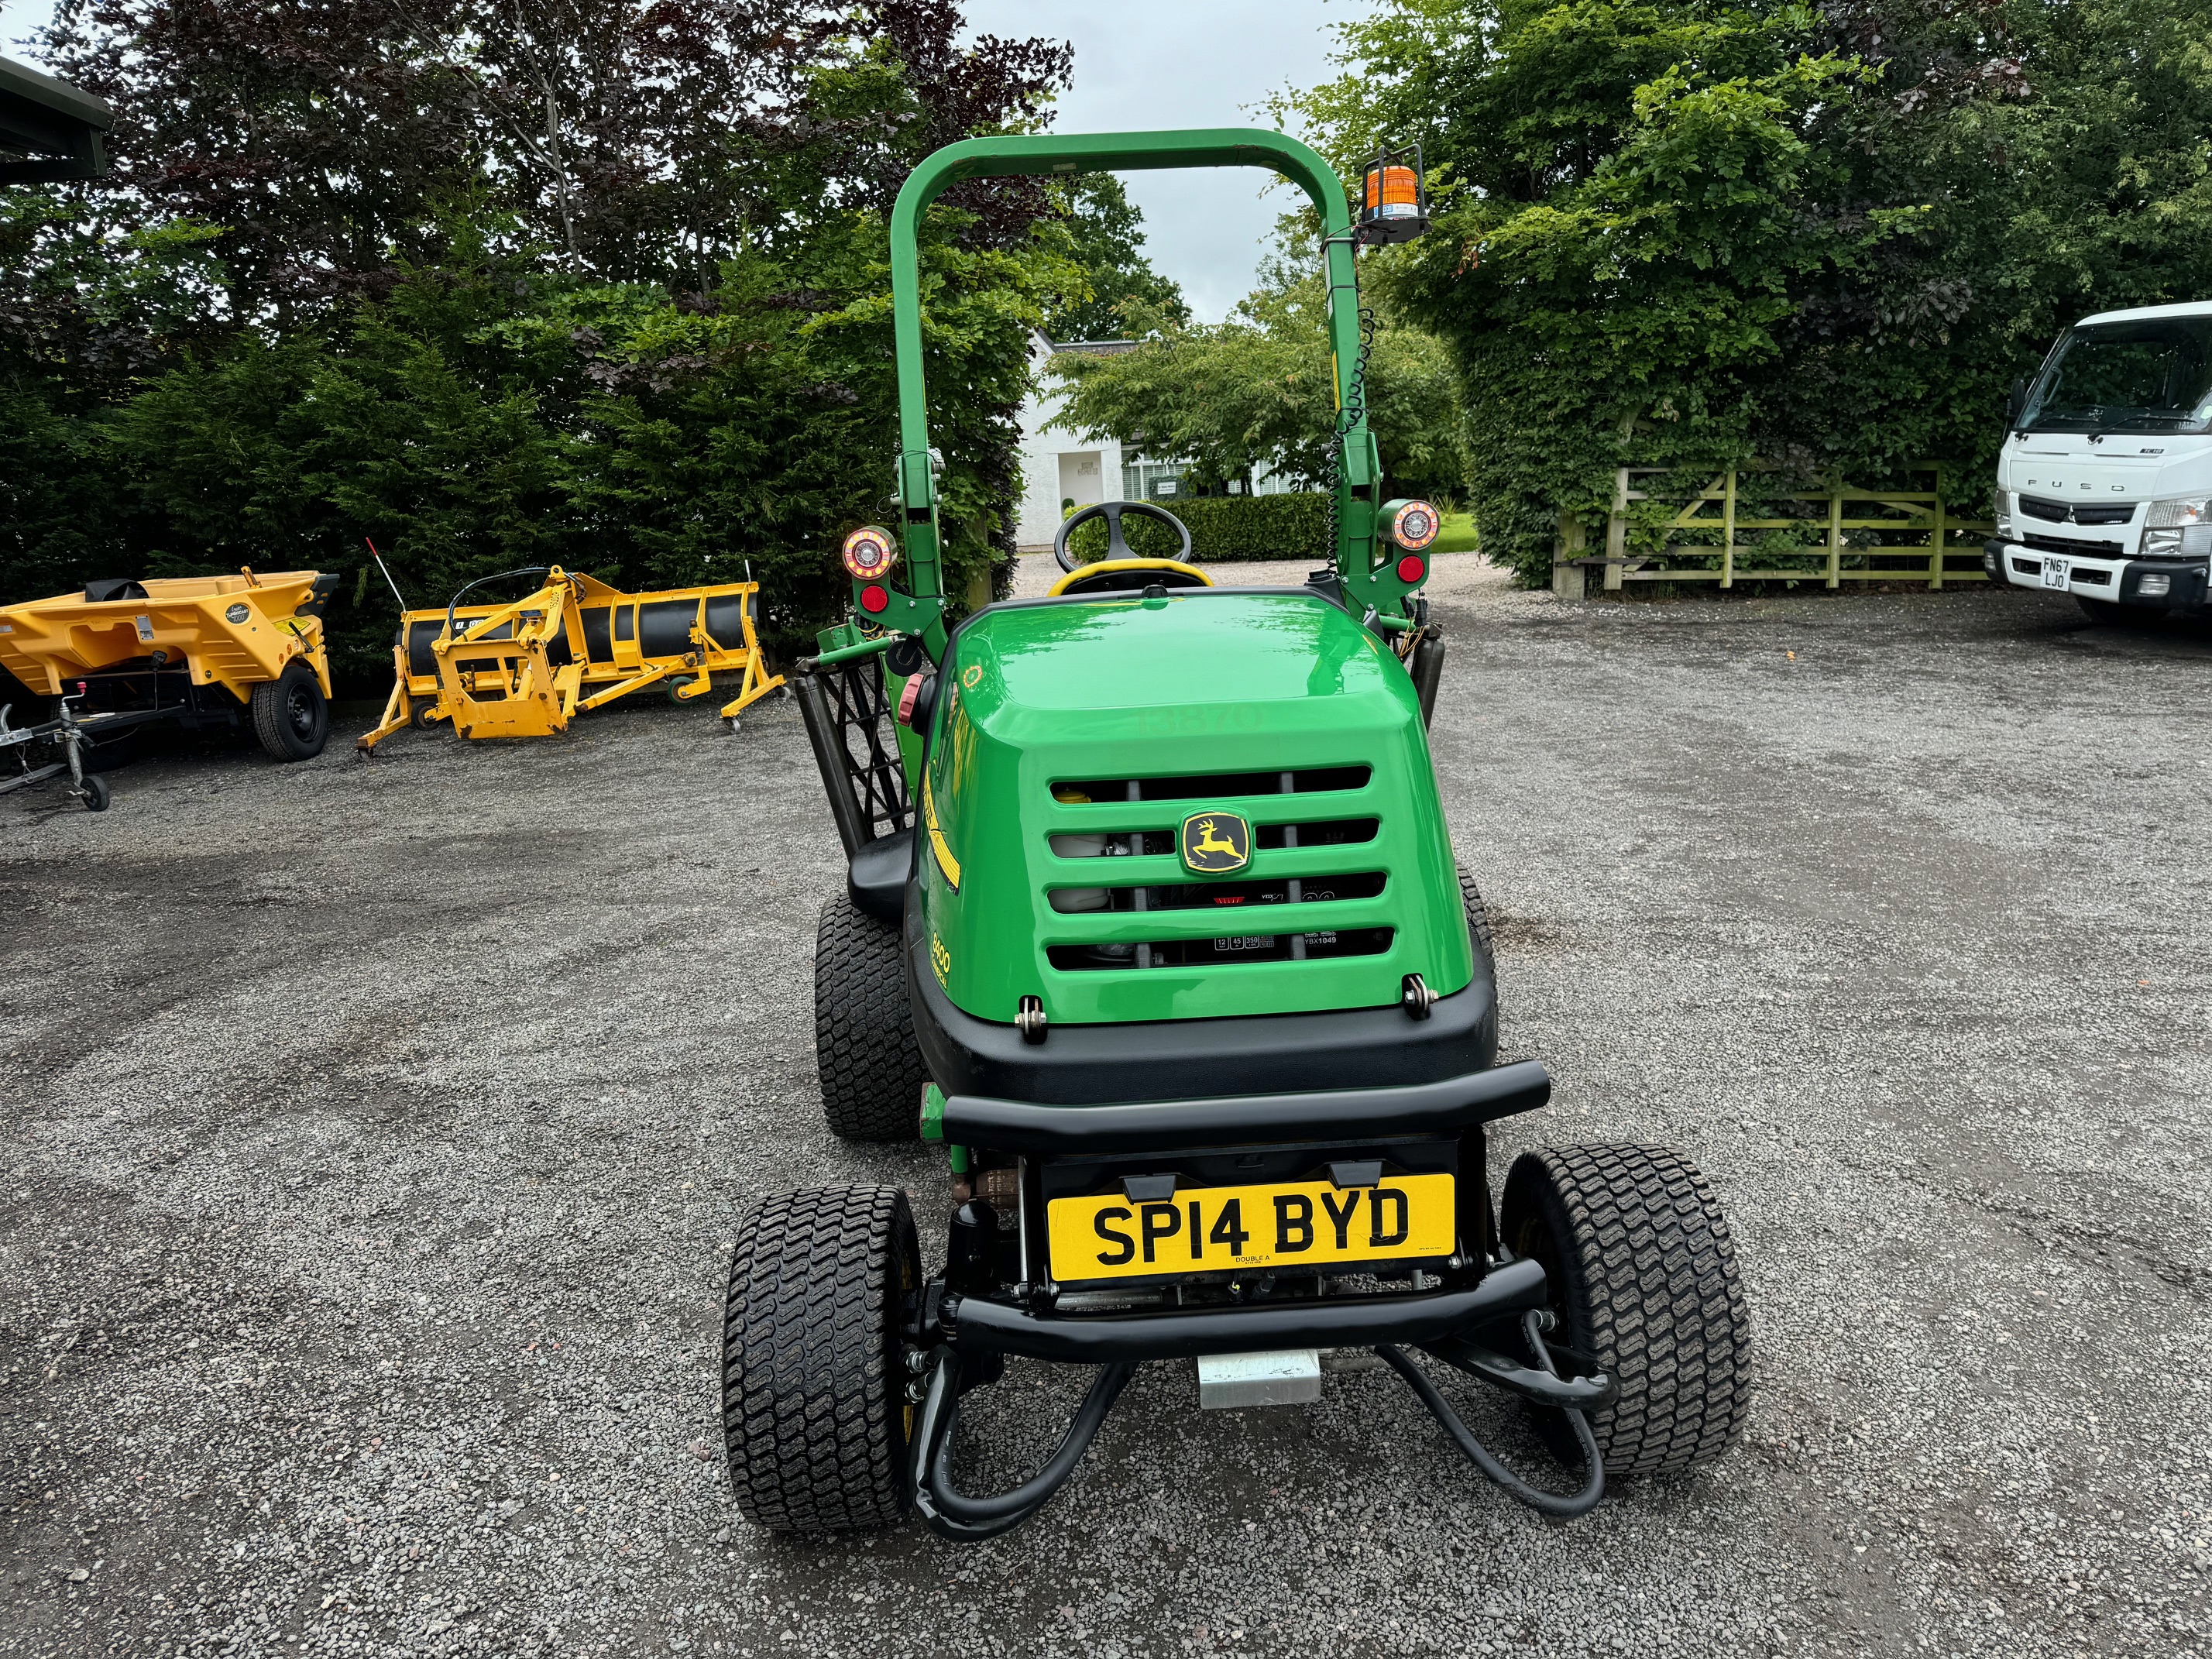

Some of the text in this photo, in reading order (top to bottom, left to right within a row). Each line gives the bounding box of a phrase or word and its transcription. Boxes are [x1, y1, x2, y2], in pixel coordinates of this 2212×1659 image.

[2028, 479, 2125, 492] FUSO
[2043, 557, 2069, 574] FN67
[2045, 572, 2064, 588] LJO
[1304, 936, 1337, 945] YBX1049
[933, 931, 950, 974] 8400
[1094, 1187, 1409, 1266] SP14 BYD
[1235, 1255, 1264, 1263] DOUBLE
